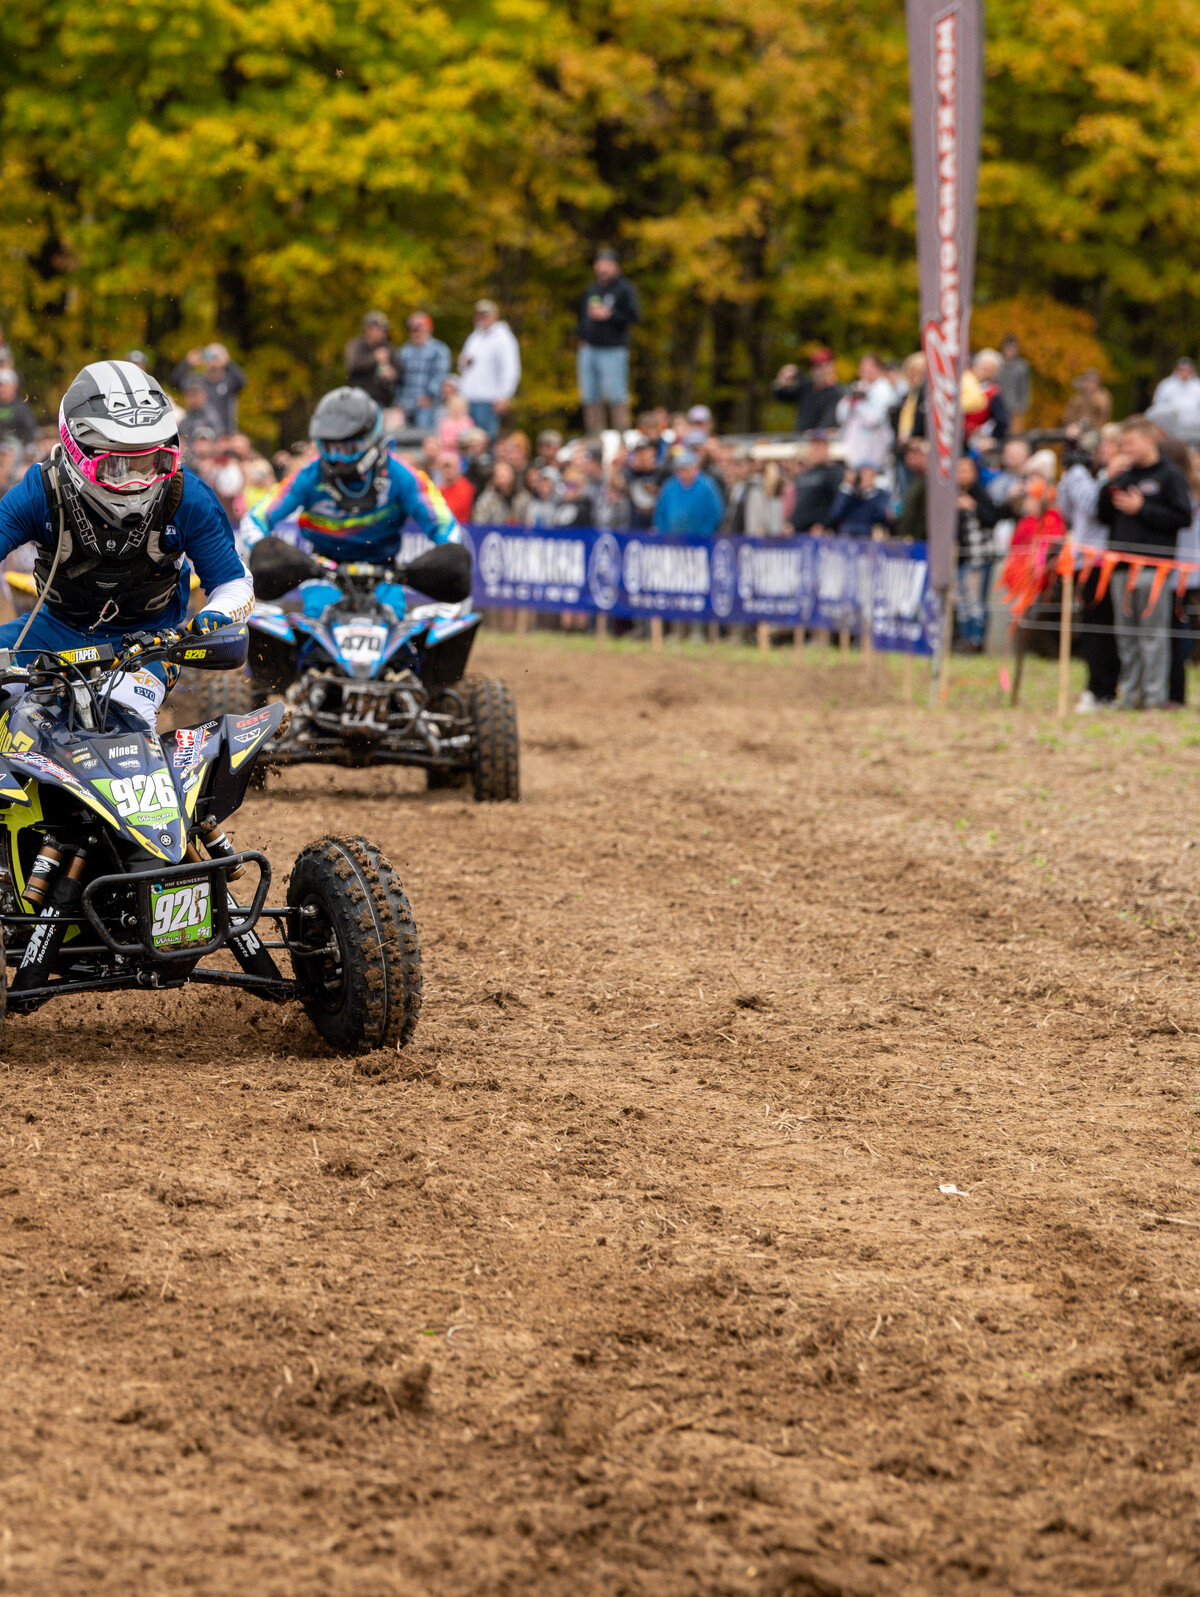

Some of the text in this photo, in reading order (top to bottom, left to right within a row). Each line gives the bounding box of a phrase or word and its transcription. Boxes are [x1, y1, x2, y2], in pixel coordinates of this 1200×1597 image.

[341, 634, 382, 653] 470
[184, 648, 207, 661] 926
[136, 686, 156, 701] EVO
[235, 710, 271, 729] GBC
[108, 744, 139, 760] Nine2
[109, 772, 179, 818] 926
[137, 810, 174, 823] WALKER
[164, 880, 176, 888] HMF
[176, 875, 209, 887] ENGINEERING
[152, 882, 210, 937] 926
